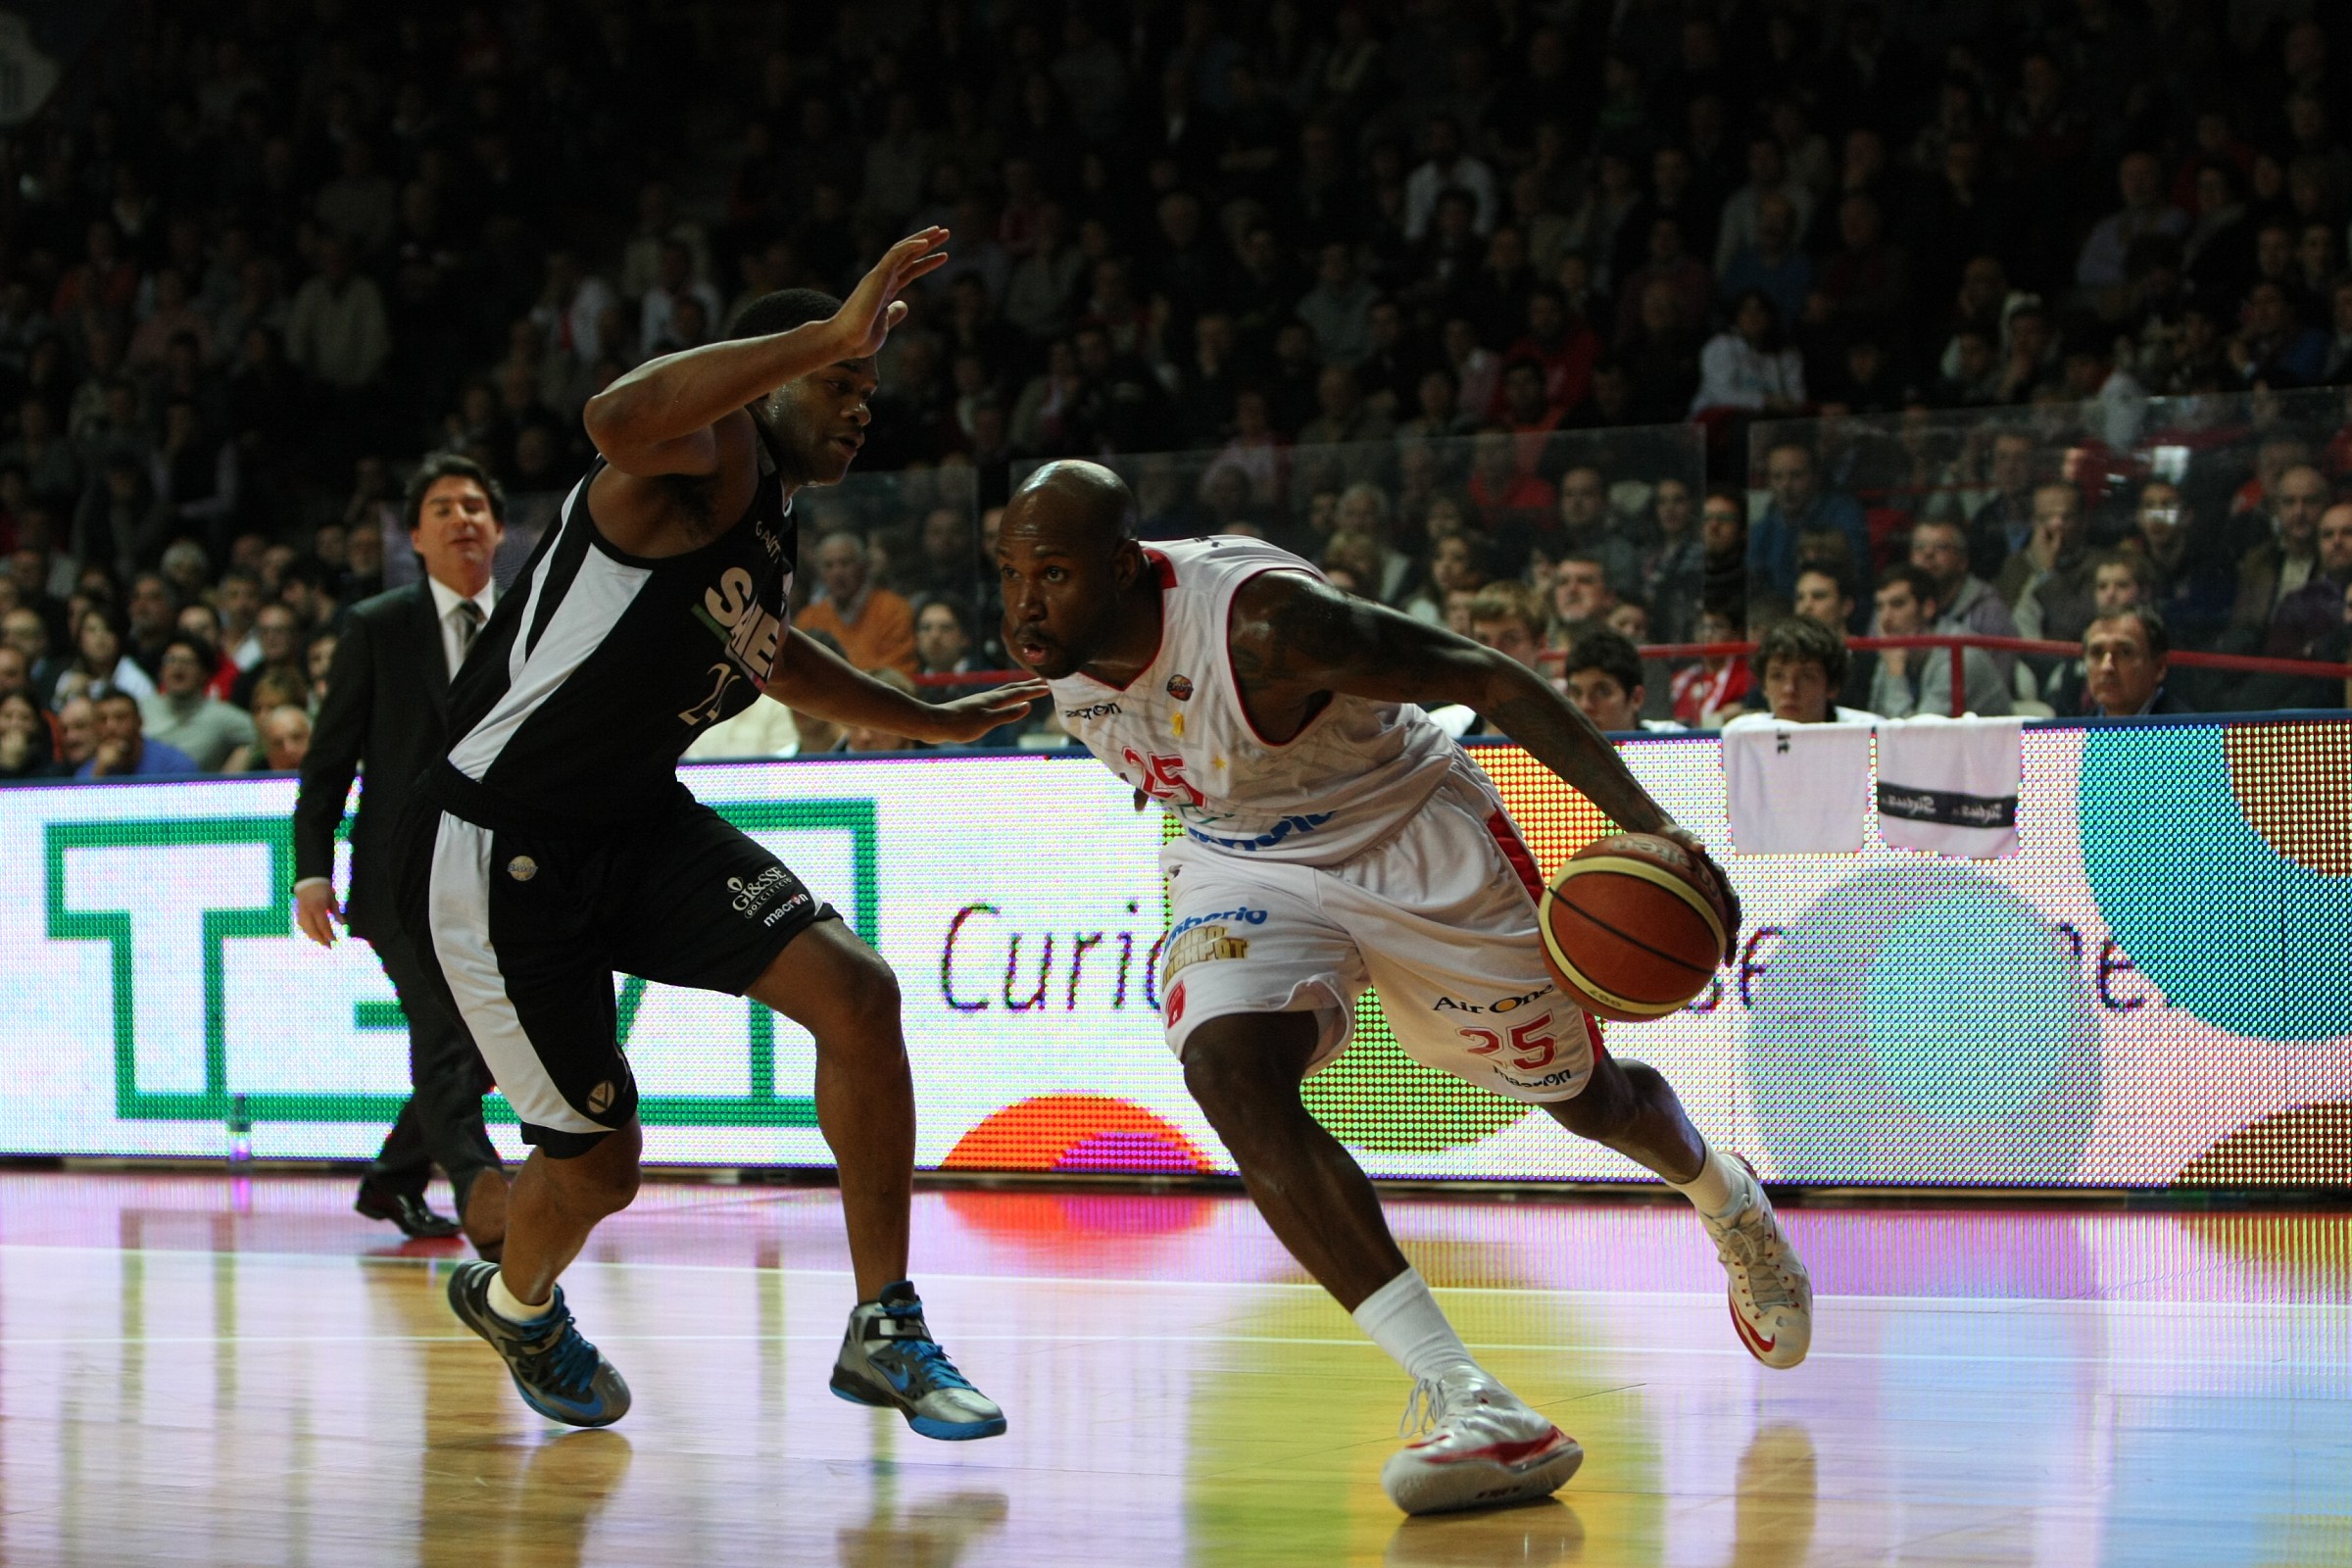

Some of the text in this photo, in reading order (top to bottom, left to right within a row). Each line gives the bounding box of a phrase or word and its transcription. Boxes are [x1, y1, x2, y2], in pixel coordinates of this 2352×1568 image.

[1065, 702, 1122, 720] acron
[732, 866, 786, 911] GI&SSE
[764, 893, 808, 927] macron
[1432, 997, 1485, 1014] Air
[1455, 1008, 1558, 1071] 25
